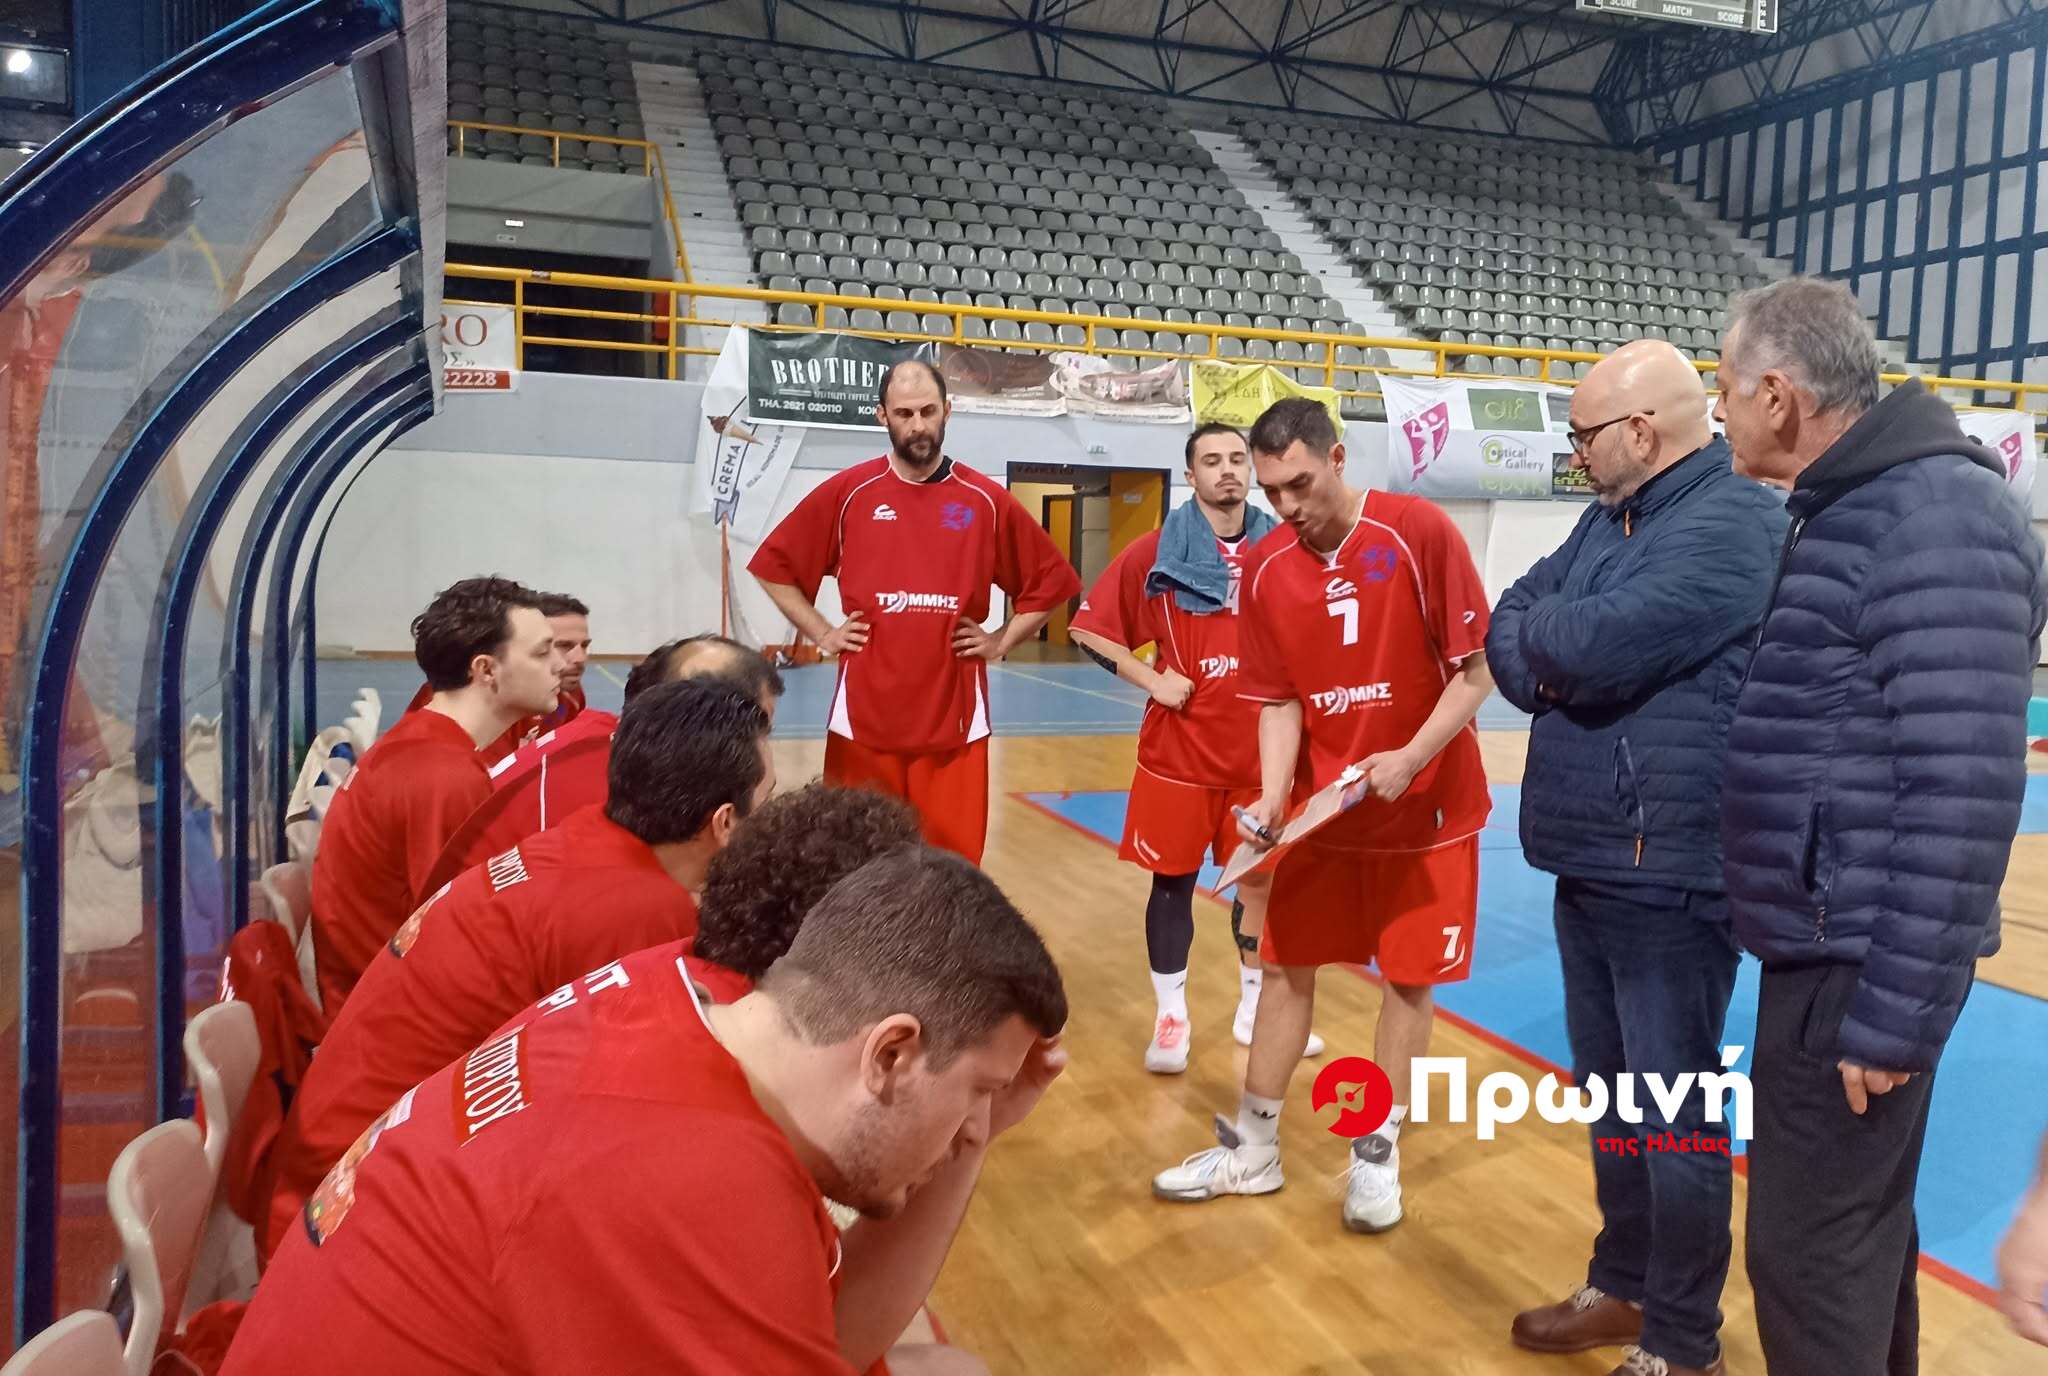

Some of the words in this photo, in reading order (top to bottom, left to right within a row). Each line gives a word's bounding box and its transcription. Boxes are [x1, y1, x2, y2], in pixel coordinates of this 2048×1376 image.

[1662, 4, 1693, 17] MATCH
[1717, 11, 1745, 25] SCORE
[717, 445, 742, 495] CREMA
[1505, 458, 1545, 473] Gallery
[1327, 598, 1359, 646] 7
[1442, 925, 1462, 960] 7
